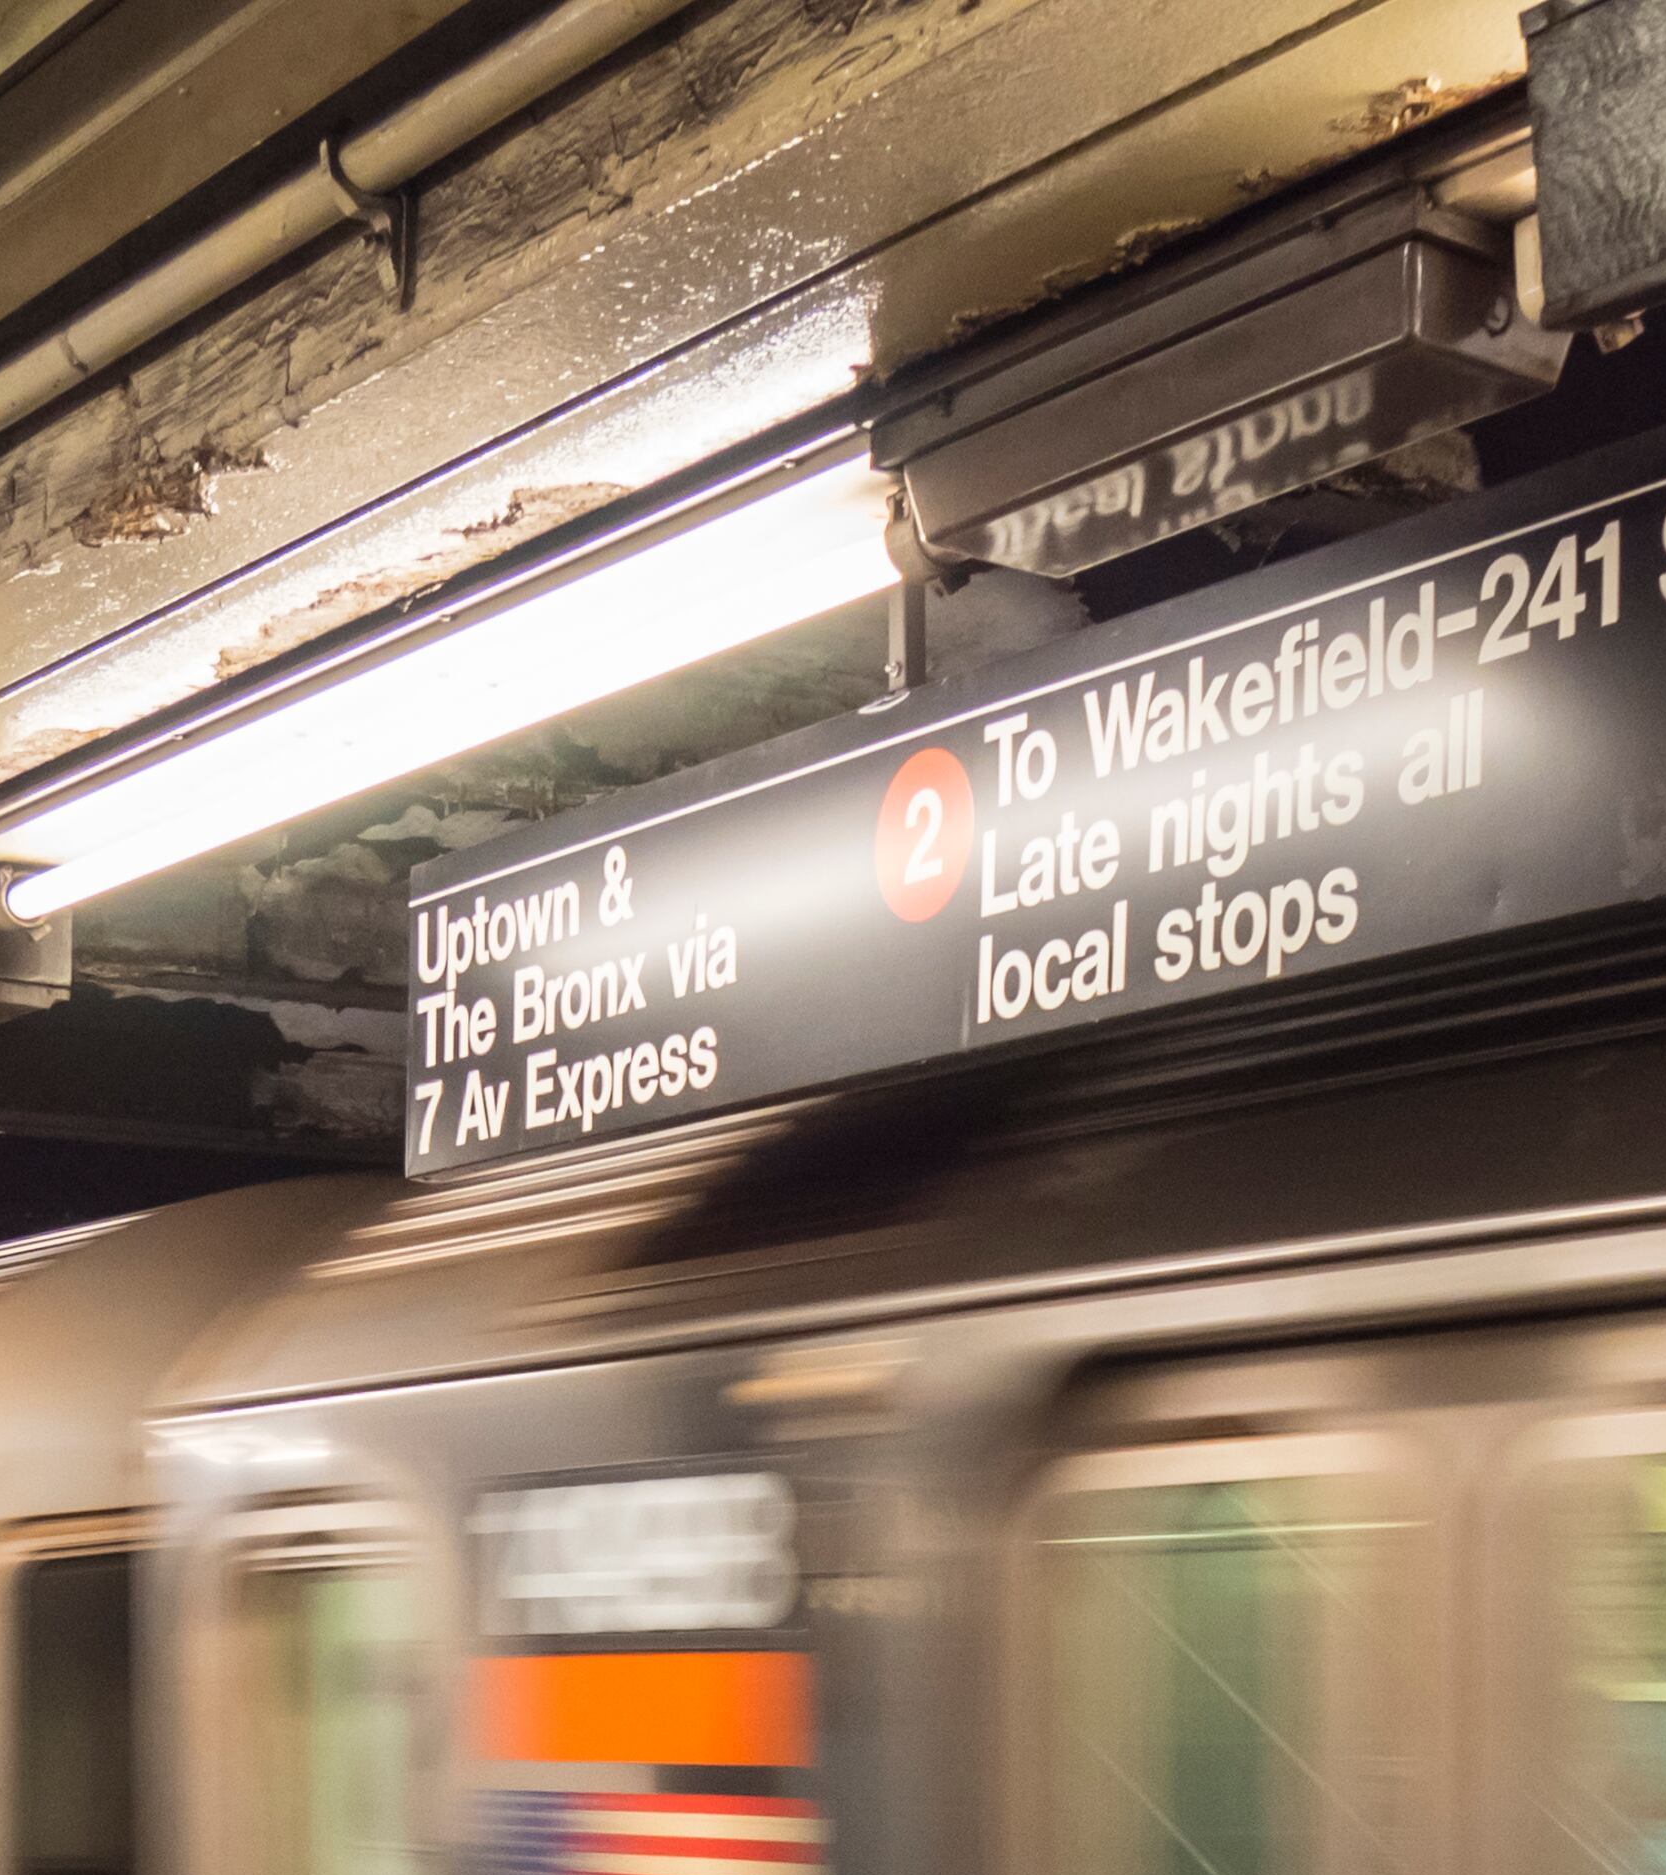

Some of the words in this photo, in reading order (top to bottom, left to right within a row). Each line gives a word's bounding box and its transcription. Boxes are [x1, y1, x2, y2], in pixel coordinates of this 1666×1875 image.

[984, 712, 1057, 808] To
[1085, 520, 1622, 778] Wakefield-241
[903, 787, 945, 886] 2
[980, 809, 1120, 918] Late
[1147, 741, 1365, 878] nights
[1398, 688, 1485, 806] all
[416, 878, 581, 990] Uptown
[598, 845, 634, 928] &
[416, 992, 497, 1068] The
[512, 952, 647, 1044] Bronx
[667, 914, 737, 999] via
[977, 902, 1128, 1024] local
[1153, 865, 1359, 978] stops
[414, 1079, 444, 1155] 7
[455, 1070, 511, 1147] Av
[525, 1026, 718, 1132] Express
